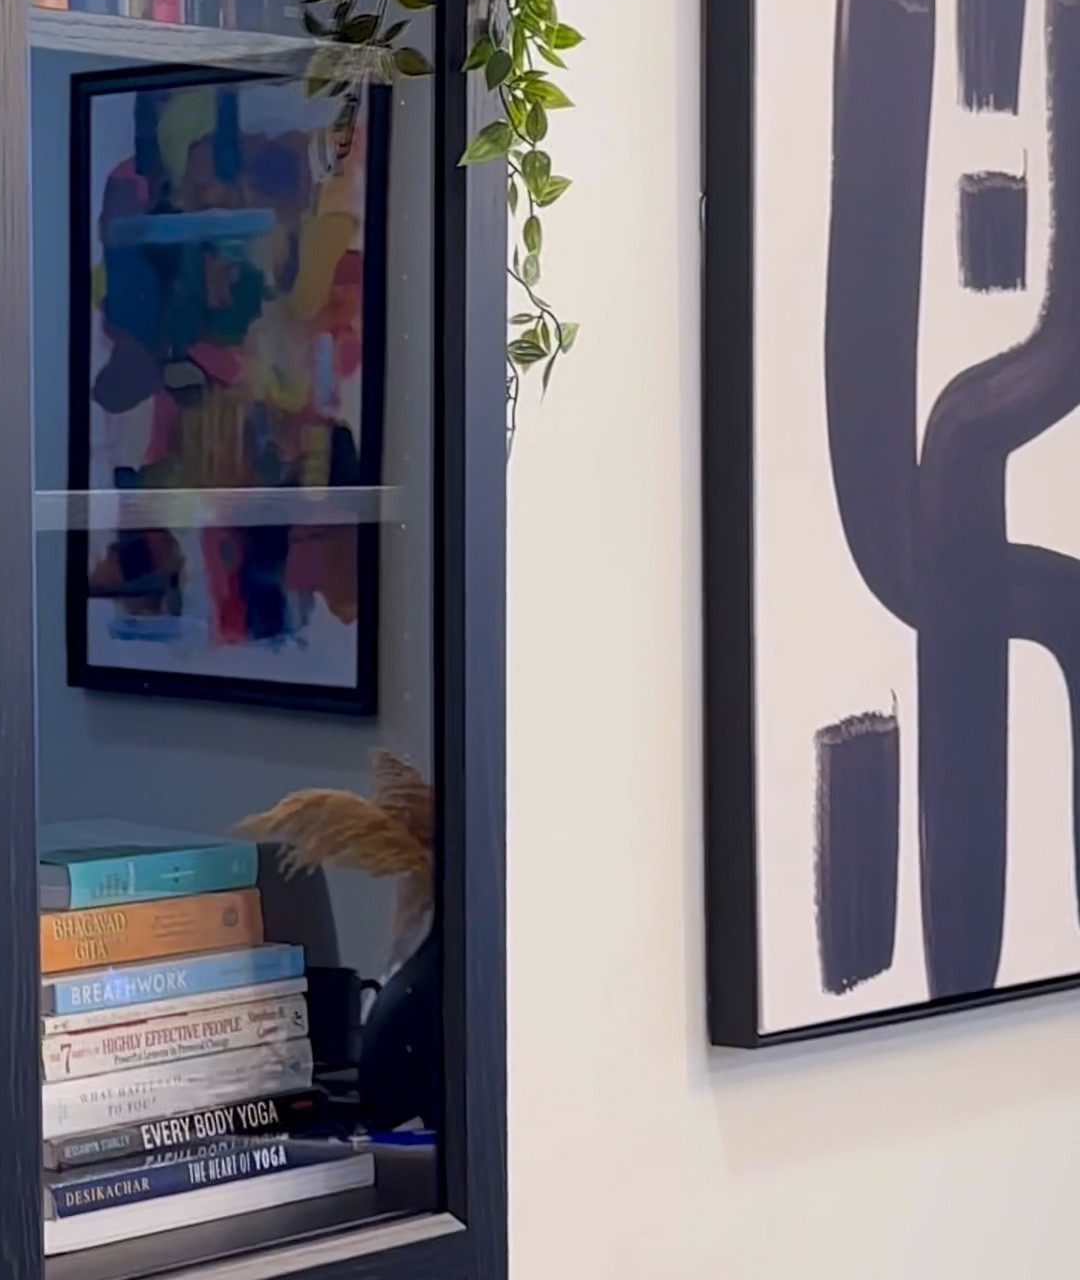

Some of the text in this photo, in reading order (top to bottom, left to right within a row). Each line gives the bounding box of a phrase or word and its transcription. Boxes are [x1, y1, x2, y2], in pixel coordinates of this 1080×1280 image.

[51, 912, 128, 942] BHAGAVAD
[74, 939, 108, 962] GITA
[71, 970, 188, 1006] BREATHWORK
[60, 1042, 73, 1075] 7
[101, 1032, 143, 1056] HIGHLY
[144, 1023, 201, 1048] EFFECTIVE
[201, 1016, 243, 1039] PEOPLE
[79, 1088, 113, 1105] WHAT
[140, 1116, 192, 1150] EVERY
[193, 1107, 237, 1140] BODY
[237, 1100, 280, 1129] YOGA
[65, 1145, 288, 1207] DESIKACHAR THE HEART OF YOGA
